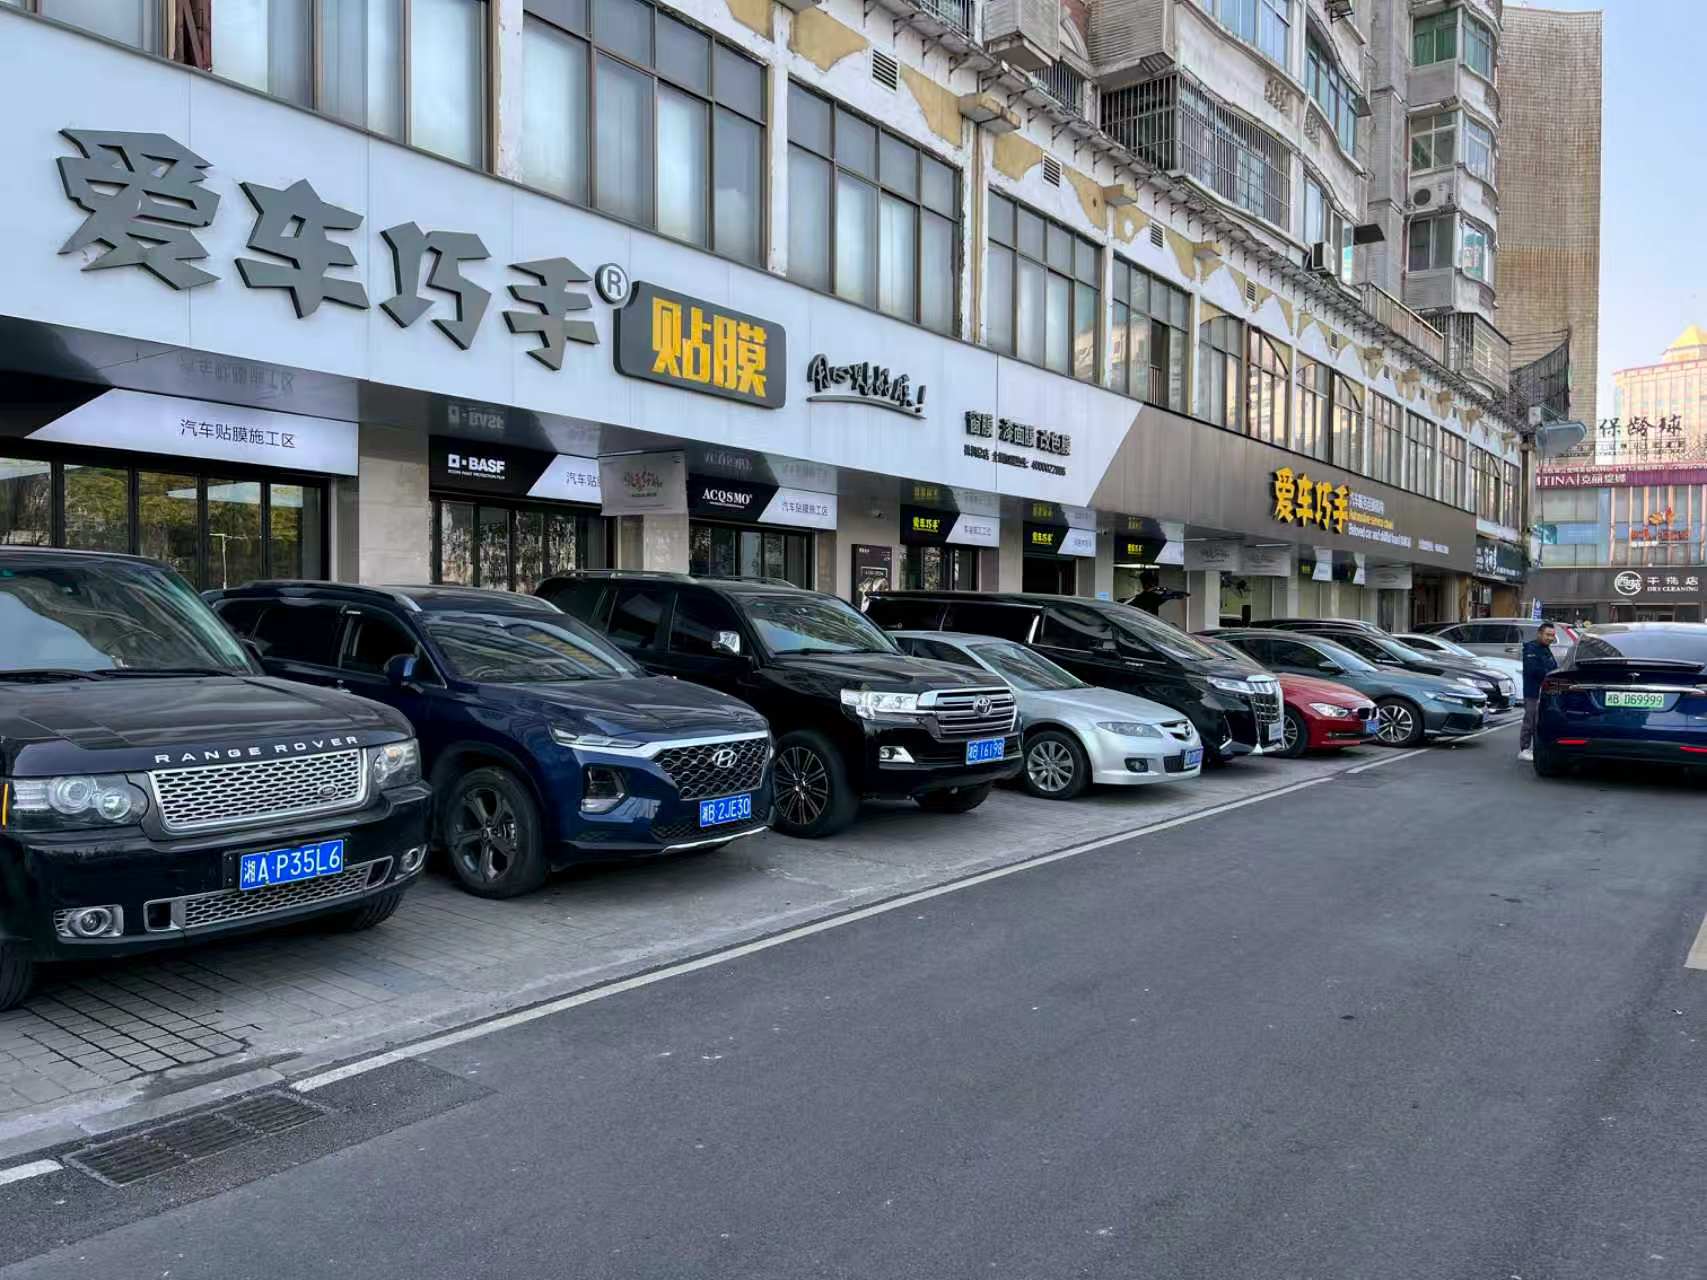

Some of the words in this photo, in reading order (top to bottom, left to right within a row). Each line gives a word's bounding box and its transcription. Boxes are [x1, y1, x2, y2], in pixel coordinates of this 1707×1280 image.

[57, 128, 599, 371] 爱车巧手
[652, 296, 767, 397] 贴膜
[180, 418, 296, 448] 汽车贴膜施工区
[1036, 429, 1072, 456] 改色膜
[469, 459, 505, 474] BASF
[1271, 466, 1350, 534] 爱车巧手
[155, 746, 261, 764] RANGE
[274, 736, 359, 753] ROVER
